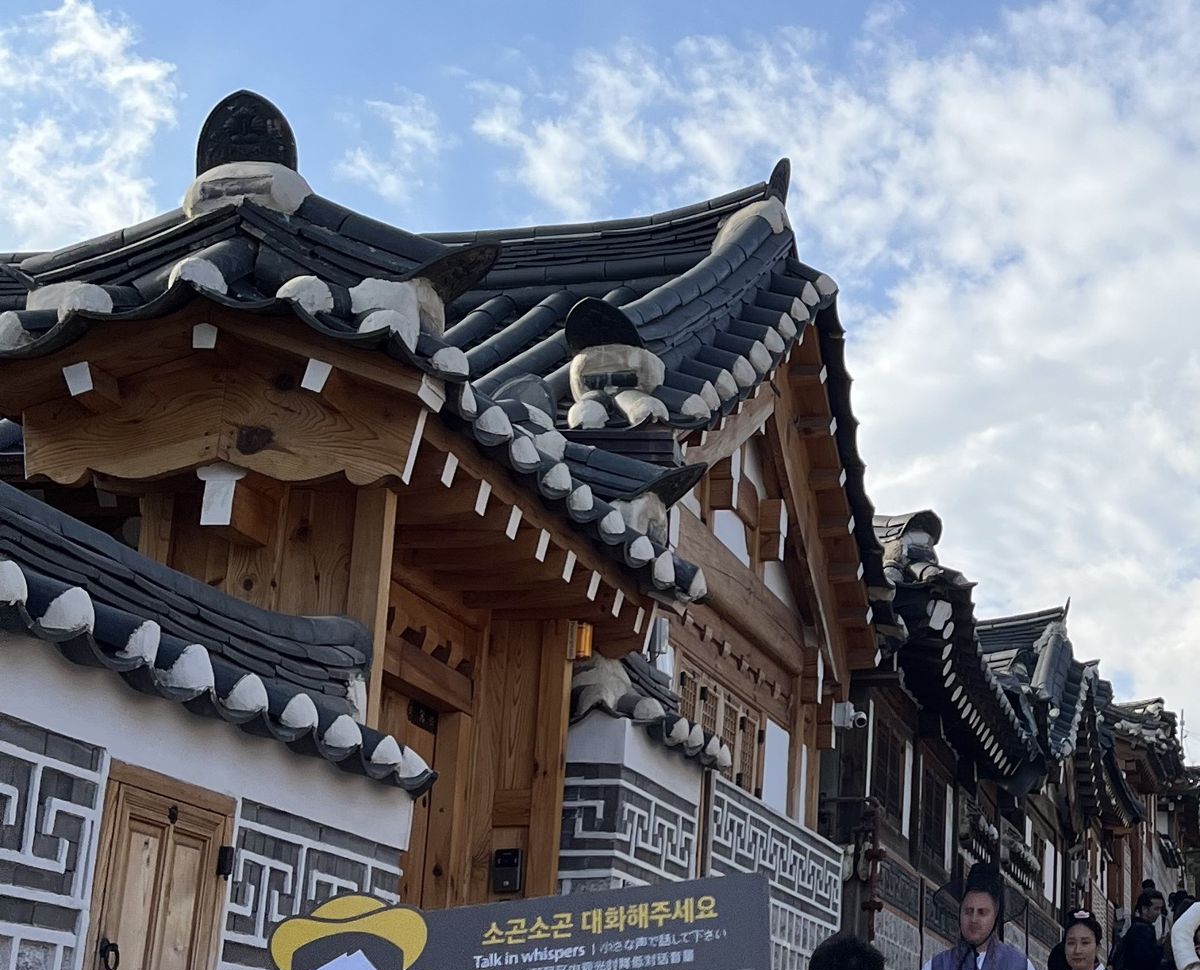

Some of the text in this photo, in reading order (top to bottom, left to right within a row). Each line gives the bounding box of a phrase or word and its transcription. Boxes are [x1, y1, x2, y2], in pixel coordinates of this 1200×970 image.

[482, 895, 719, 945] 소곤소곤 대화해주세요
[473, 945, 586, 969] Talk in whispers
